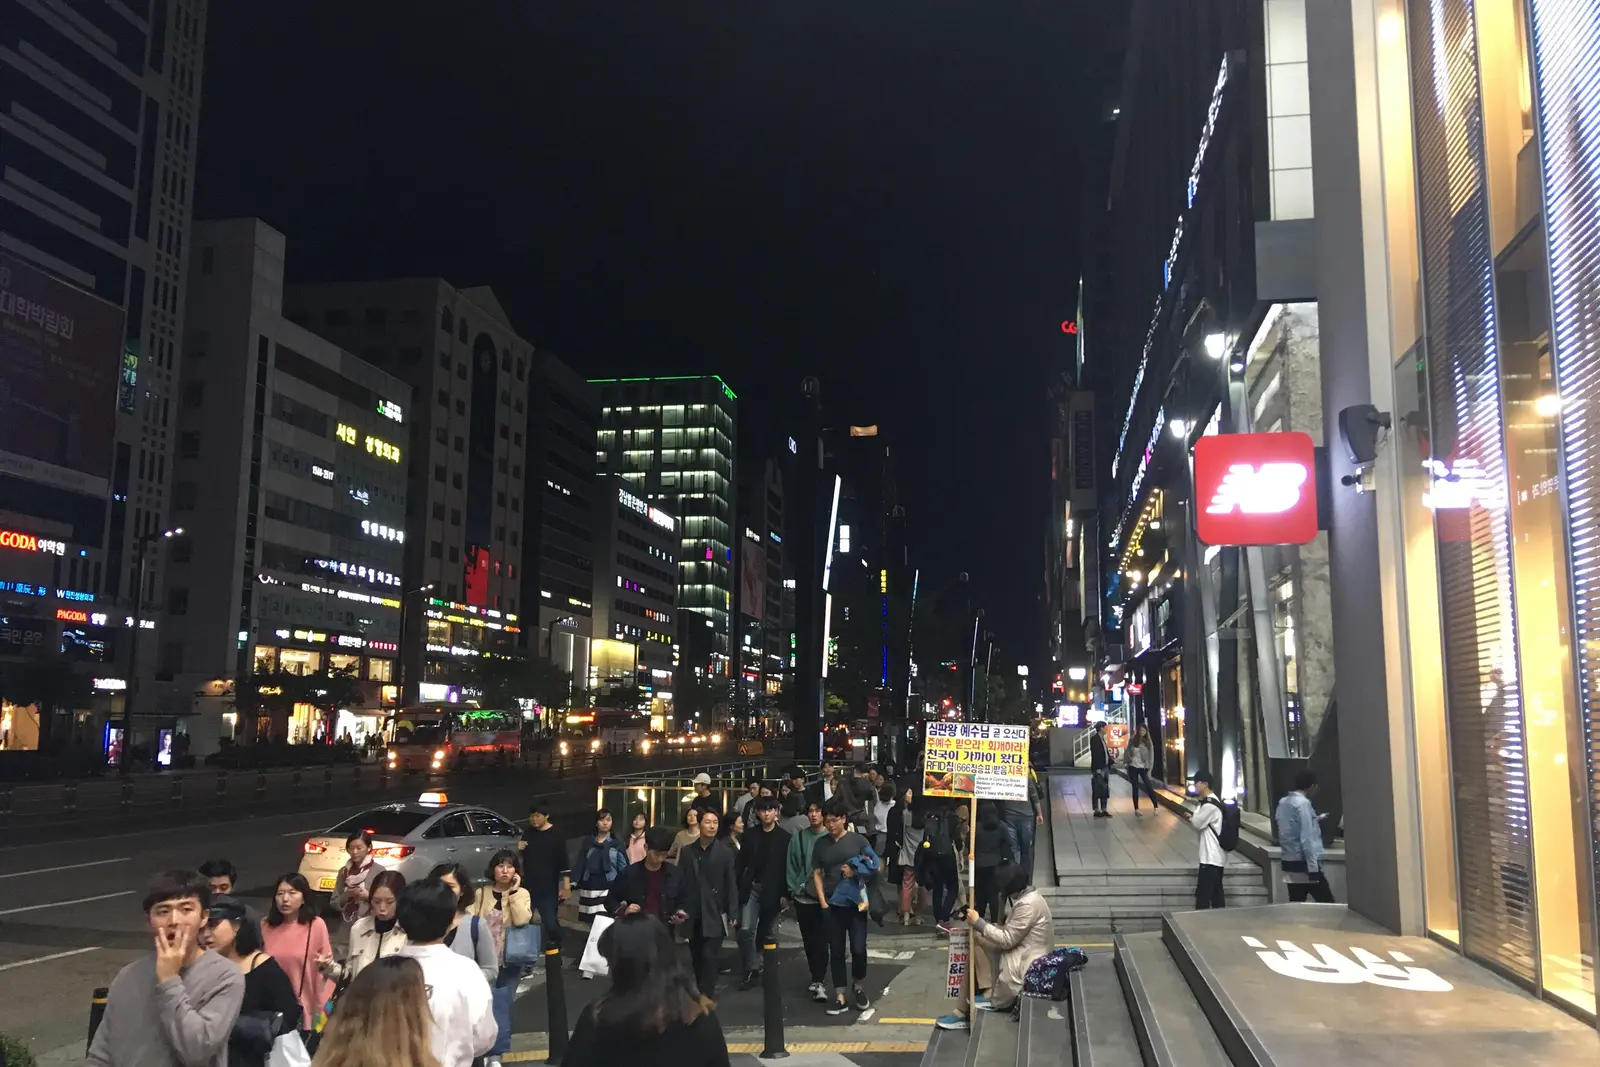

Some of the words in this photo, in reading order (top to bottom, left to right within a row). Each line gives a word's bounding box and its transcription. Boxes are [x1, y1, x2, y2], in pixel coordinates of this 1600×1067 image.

[928, 723, 957, 737] 심판왕
[960, 724, 990, 739] 예수님
[1003, 728, 1027, 740] 오신다
[927, 737, 952, 749] 주예수
[927, 749, 959, 761] 천국이
[963, 751, 996, 764] 가까이
